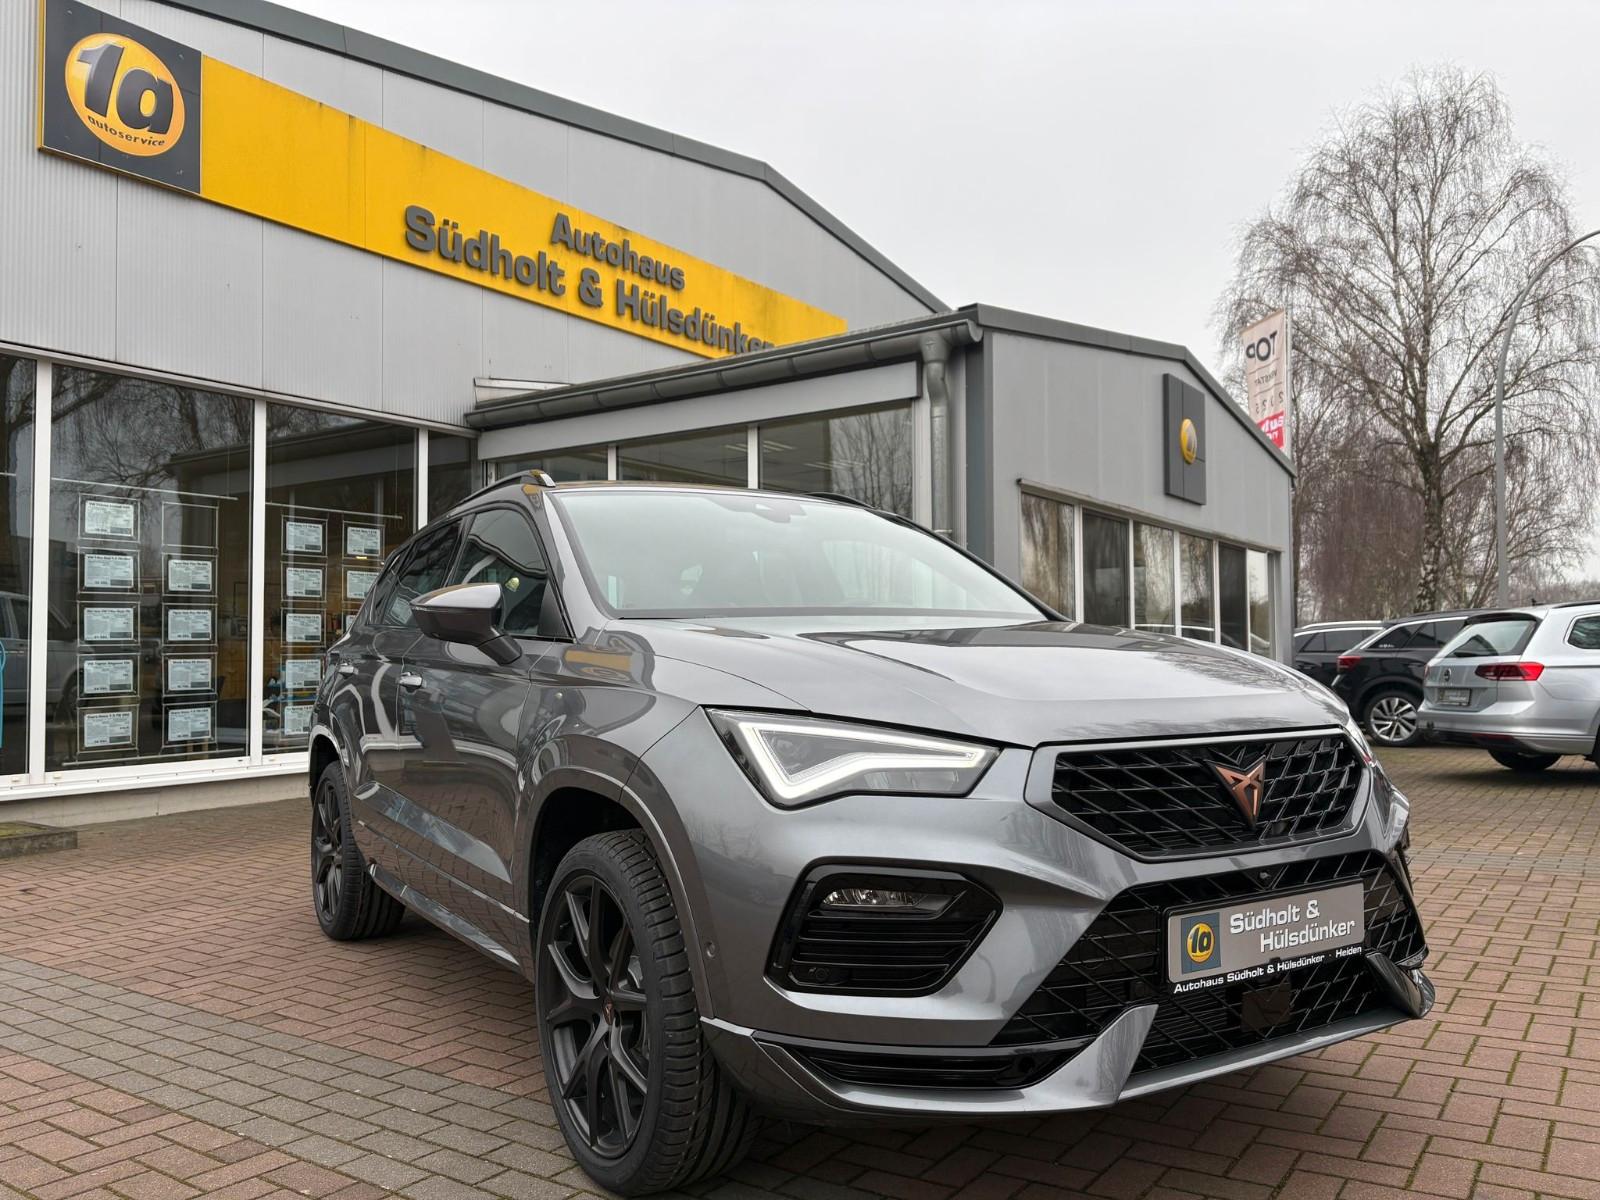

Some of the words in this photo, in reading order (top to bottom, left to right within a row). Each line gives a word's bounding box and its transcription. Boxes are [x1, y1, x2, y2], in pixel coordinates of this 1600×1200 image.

[77, 43, 174, 135] 1a
[88, 115, 166, 147] autoservice
[405, 205, 566, 296] Südholt
[578, 267, 603, 307] &
[551, 212, 685, 290] Autohaus
[1230, 903, 1301, 935] Südholt
[1306, 899, 1321, 919] &
[1260, 919, 1356, 953] Hülsdünker
[1173, 976, 1225, 994] Autohaus
[1226, 967, 1265, 982] Südholt
[1266, 964, 1276, 974] &
[1277, 954, 1326, 972] Hülsdünker
[1335, 946, 1363, 958] Heiden
